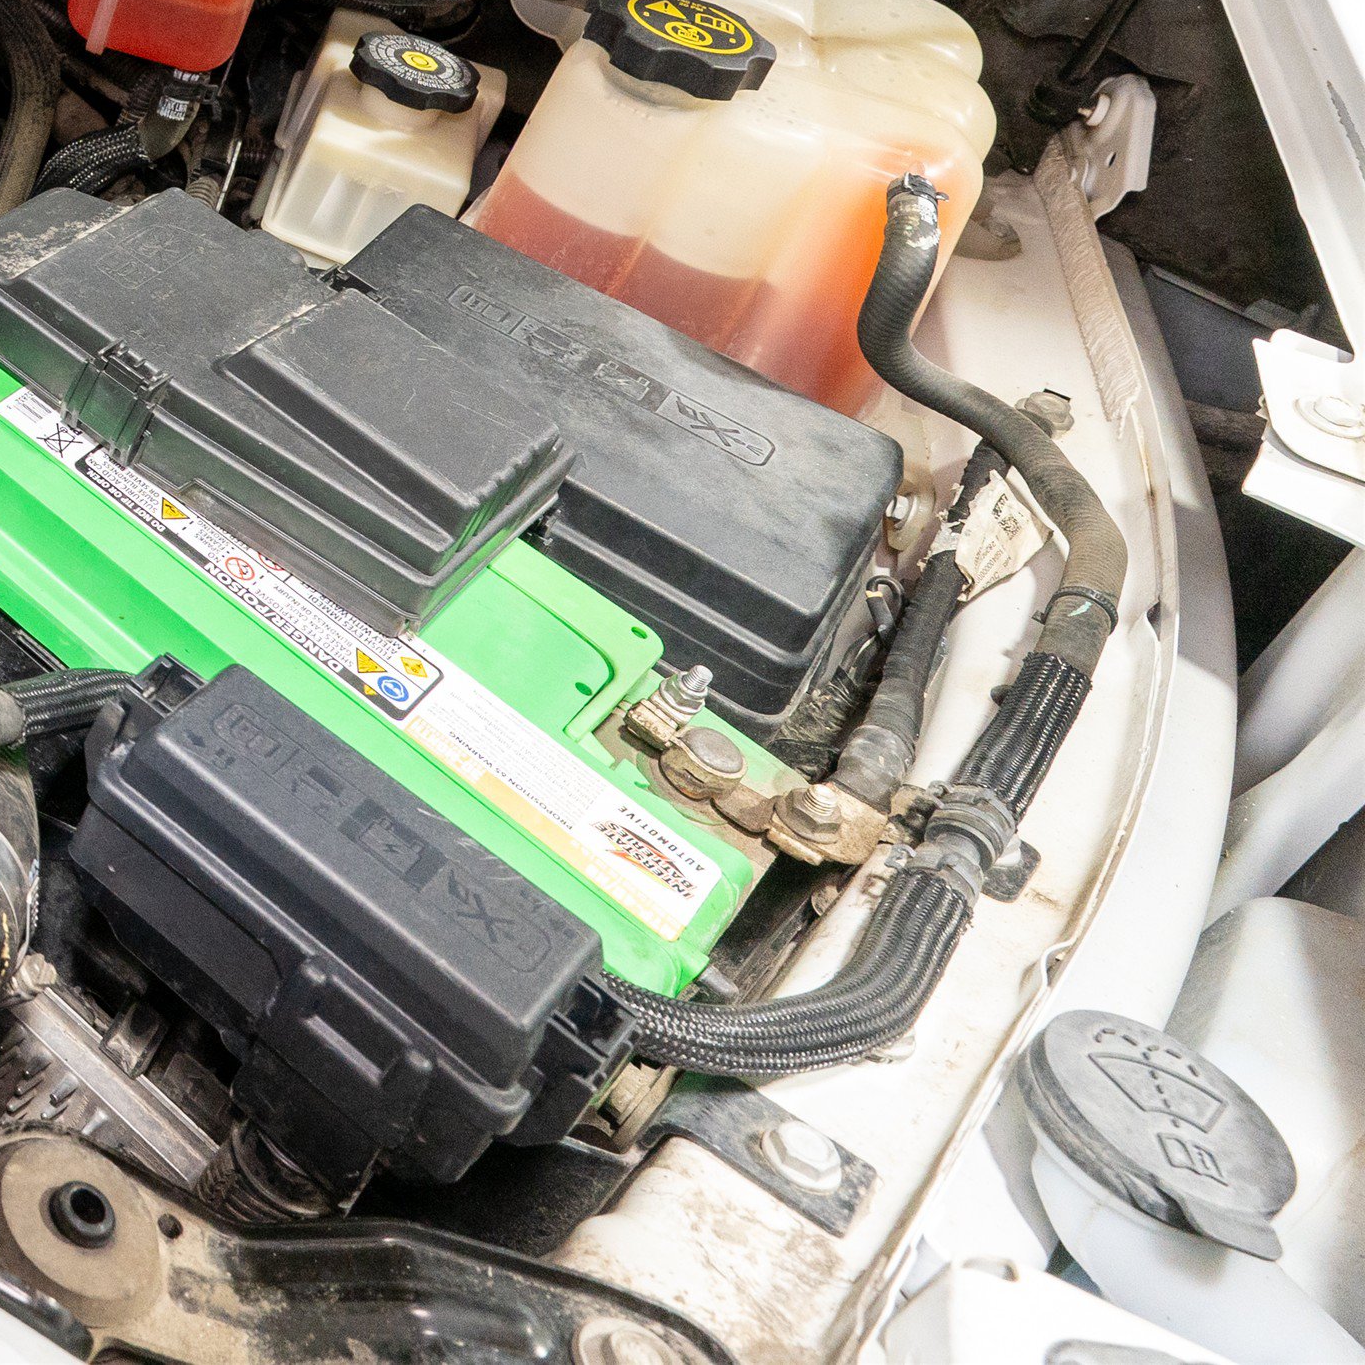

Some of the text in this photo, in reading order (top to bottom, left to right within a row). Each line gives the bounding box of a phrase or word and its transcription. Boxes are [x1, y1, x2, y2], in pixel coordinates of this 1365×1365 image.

[87, 457, 158, 514] SULFURIC ACID CAN
[100, 459, 160, 507] CAUSE BLINDNESS
[123, 468, 150, 490] SEVERE
[147, 487, 161, 498] OR
[84, 466, 166, 532] DO NOT TIP OR OPEN.
[192, 531, 222, 555] SPARKS
[195, 519, 231, 547] SMOKING
[197, 527, 226, 551] FLAMES
[205, 550, 222, 564] NO
[200, 559, 345, 673] DANGER/POISON
[253, 586, 300, 625] EXPLOSIVE
[283, 601, 309, 622] CAUSE
[298, 604, 313, 616] OR
[304, 591, 343, 622] IMMEDI-
[307, 619, 325, 635] CAN
[310, 613, 354, 648] BLINDNESS
[340, 619, 364, 639] EYES
[345, 613, 373, 636] WITH
[321, 640, 354, 668] SHIELD
[322, 632, 353, 657] GASES
[361, 635, 393, 661] FLUSH
[369, 632, 398, 656] ATELY
[446, 729, 495, 768] WARNING
[492, 765, 508, 778] 65
[505, 775, 575, 830] PROPOSITION
[615, 803, 706, 873] AUTOMOTIVE
[591, 819, 693, 899] INTERSTATE
[604, 819, 695, 890] BATTERIES
